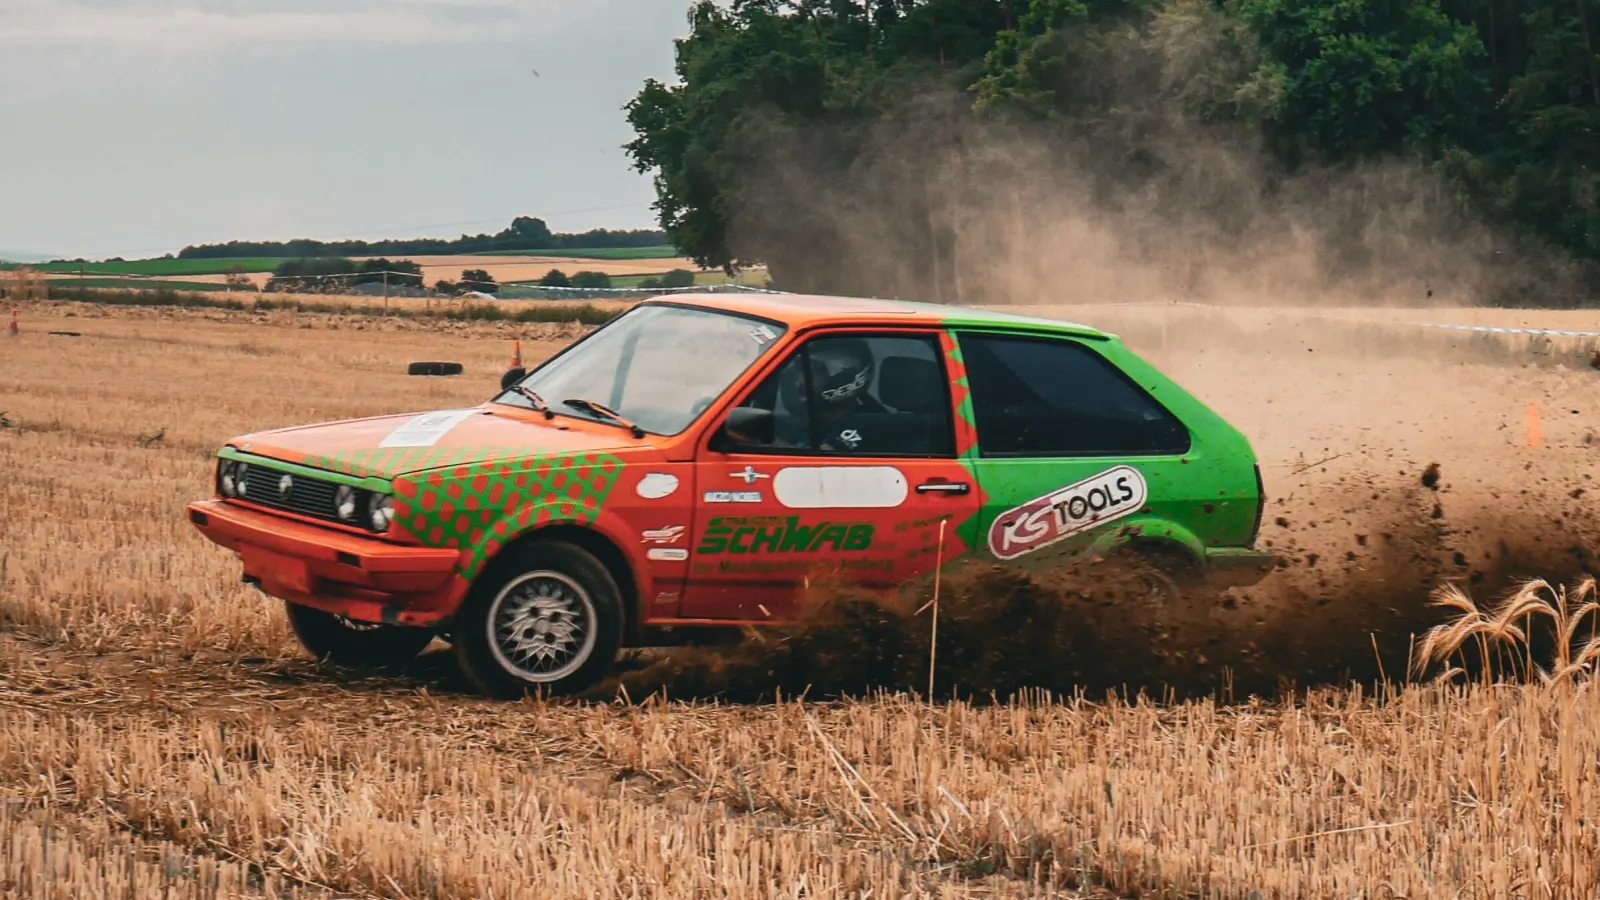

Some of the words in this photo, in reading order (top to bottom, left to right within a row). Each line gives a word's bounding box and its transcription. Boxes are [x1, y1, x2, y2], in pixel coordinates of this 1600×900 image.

[696, 516, 874, 554] SCHWAB
[1001, 504, 1053, 551] KS
[1053, 477, 1133, 525] TOOLS
